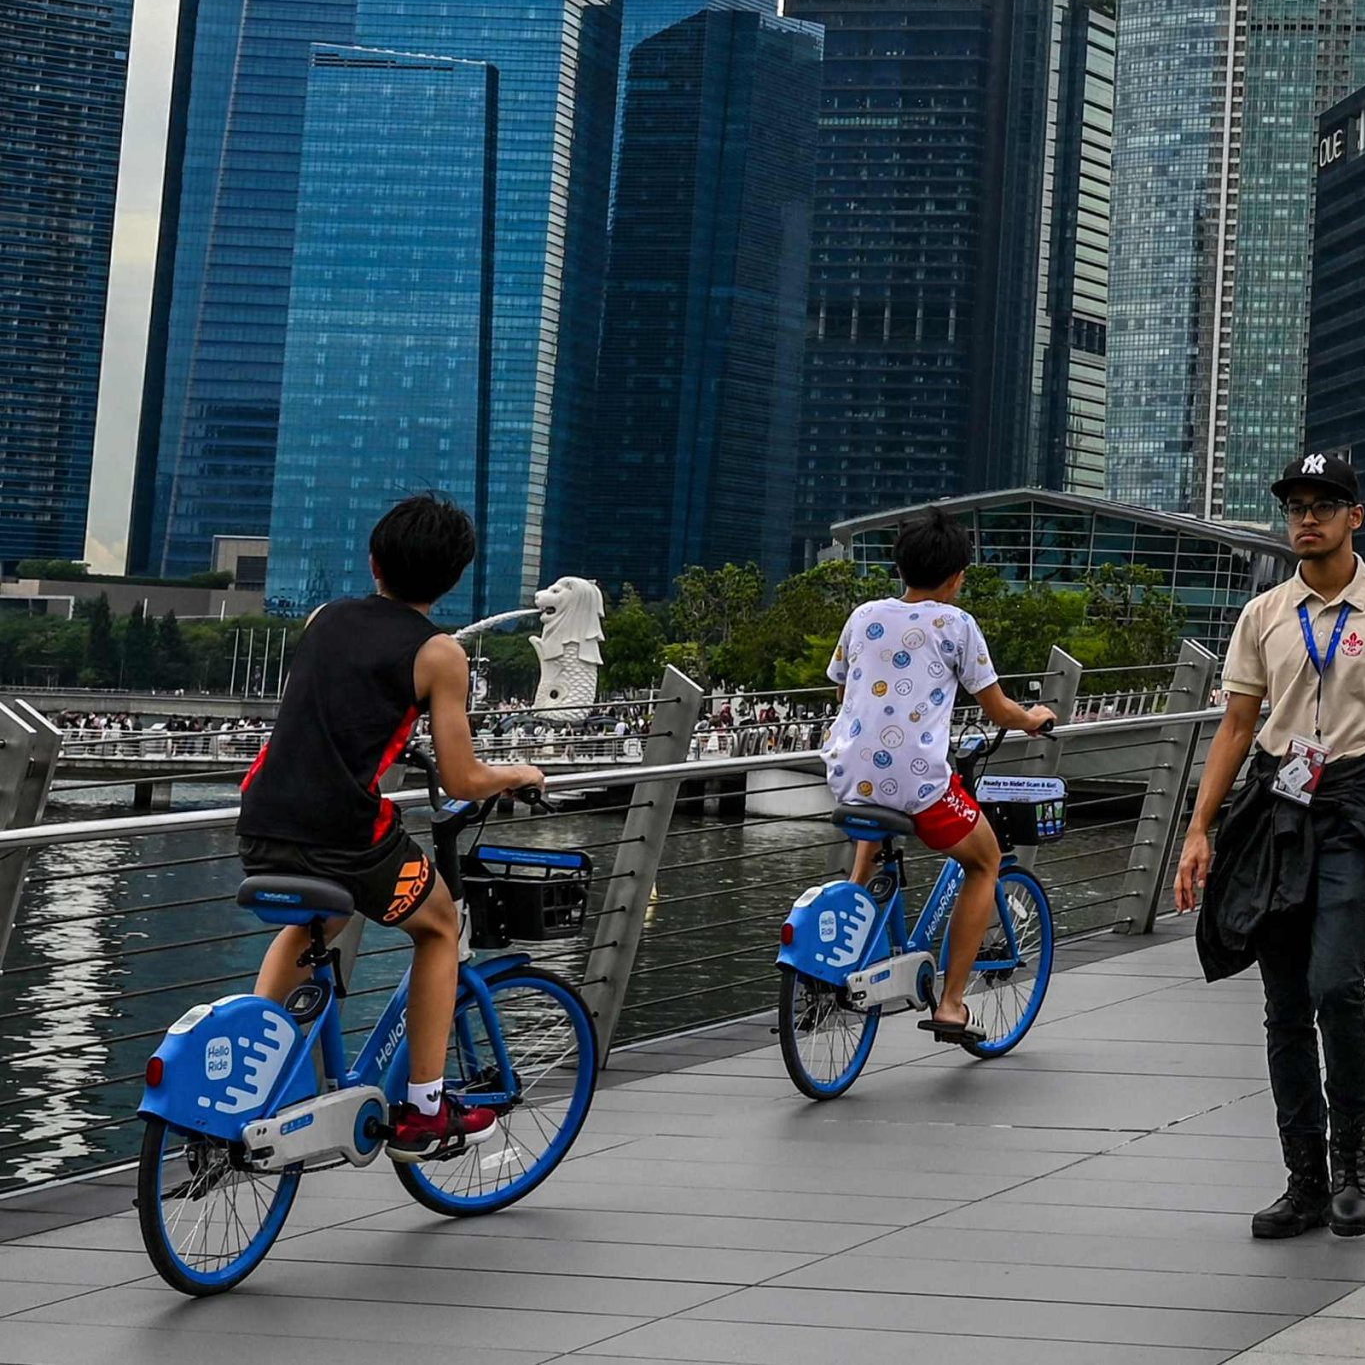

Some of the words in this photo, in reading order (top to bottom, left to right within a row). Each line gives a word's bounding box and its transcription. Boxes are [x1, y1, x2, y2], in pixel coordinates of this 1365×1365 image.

[1319, 129, 1344, 168] OUE
[1301, 453, 1327, 474] NY
[924, 879, 957, 942] HelloRide
[207, 1045, 229, 1059] Hello
[208, 1059, 228, 1072] Ride
